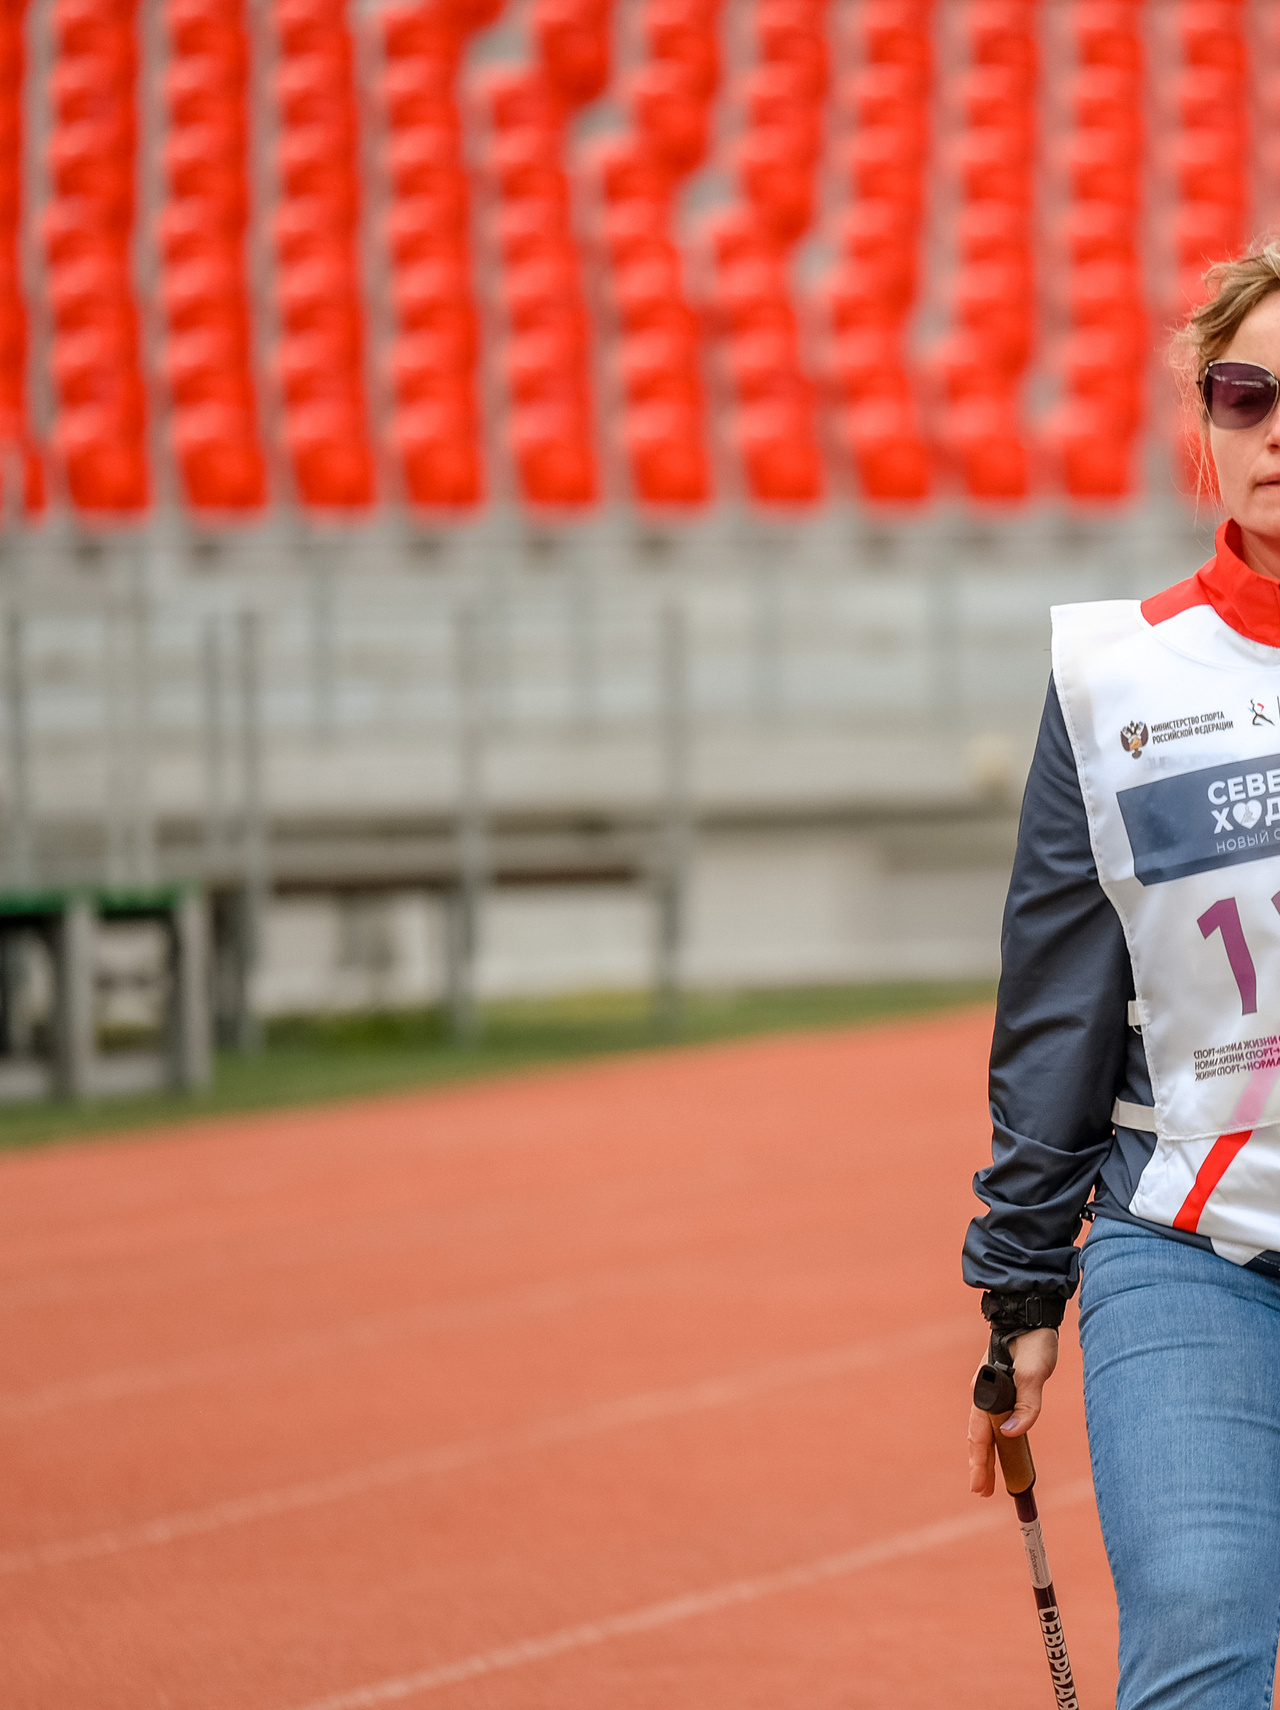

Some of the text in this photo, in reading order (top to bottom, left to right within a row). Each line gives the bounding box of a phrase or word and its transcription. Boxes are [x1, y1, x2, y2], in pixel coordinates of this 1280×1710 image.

[1151, 711, 1225, 733] МИНИСТЕРСТВО СПОРТА
[1152, 721, 1234, 744] РОССИЙСКОЙ ФЕДЕРАЦИИ
[1216, 829, 1269, 853] НОВЫЙ
